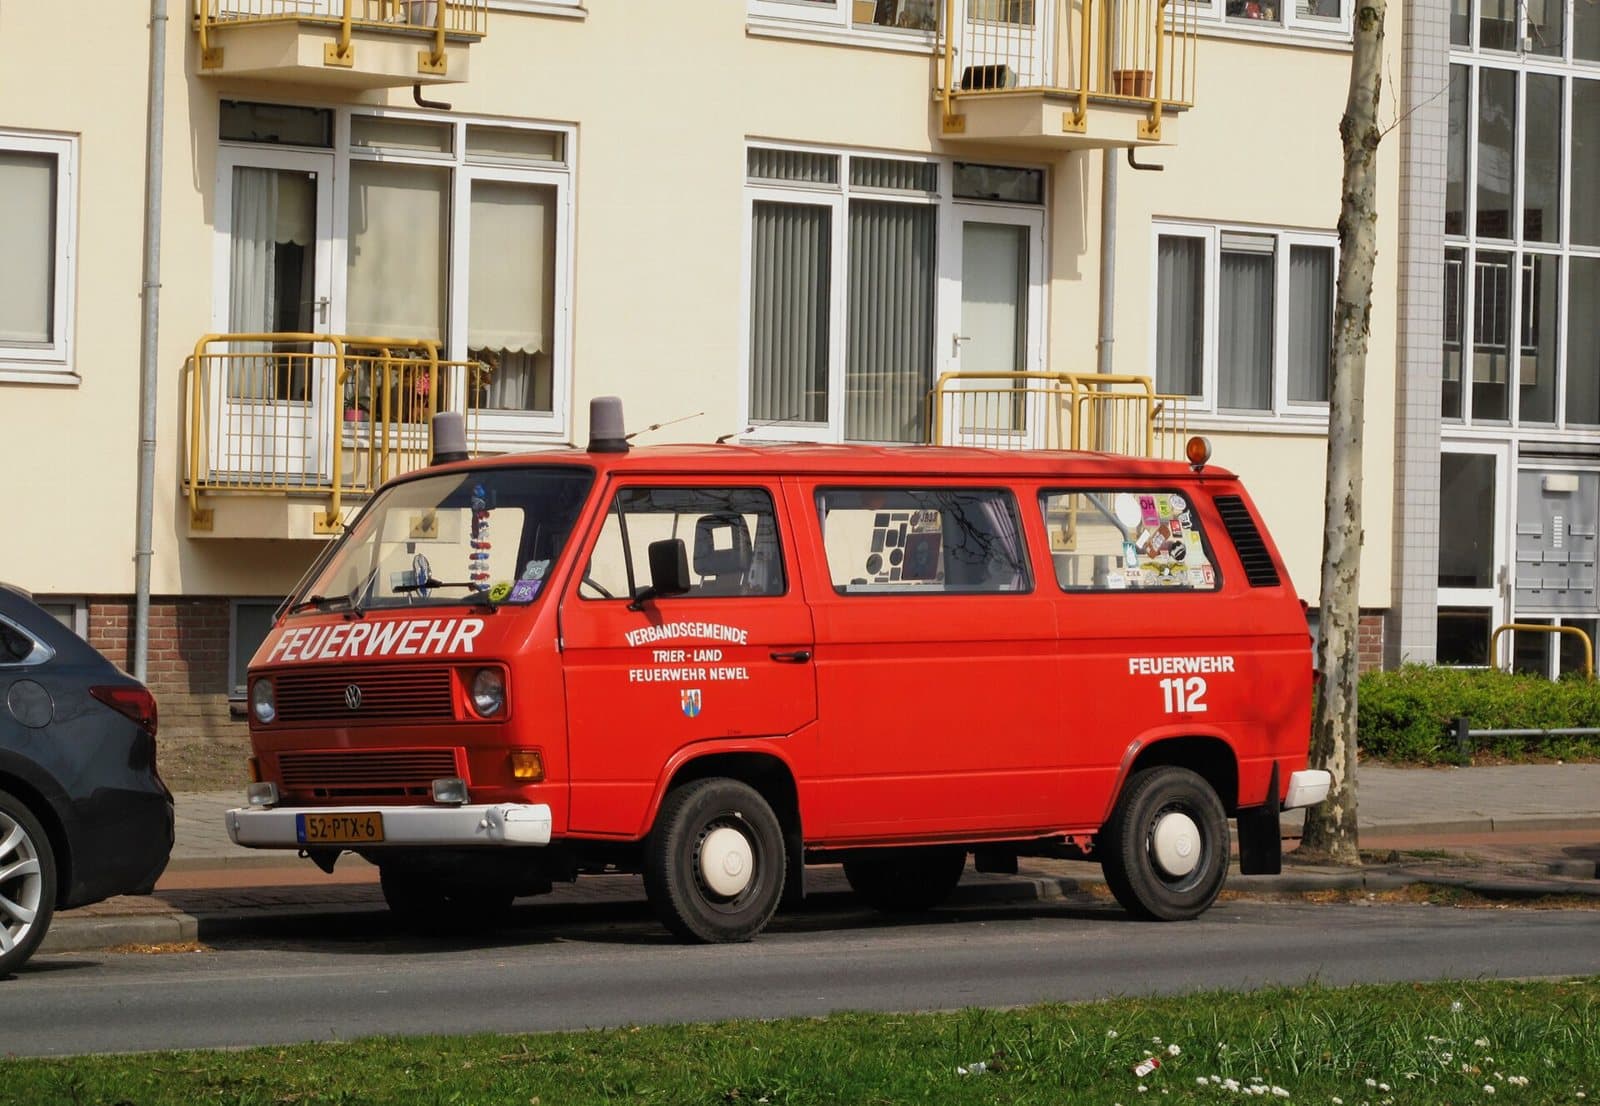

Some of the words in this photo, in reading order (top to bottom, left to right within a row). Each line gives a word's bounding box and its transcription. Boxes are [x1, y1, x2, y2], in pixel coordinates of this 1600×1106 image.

[266, 618, 484, 663] FEUERWEHR
[625, 622, 748, 647] VERBANDSGEMEINDE
[629, 668, 706, 682] FEUERWEHR
[709, 667, 749, 680] NEWEL
[1128, 656, 1235, 675] FEUERWEHR
[1159, 676, 1208, 713] 112
[309, 817, 376, 838] 52-PTX-6
